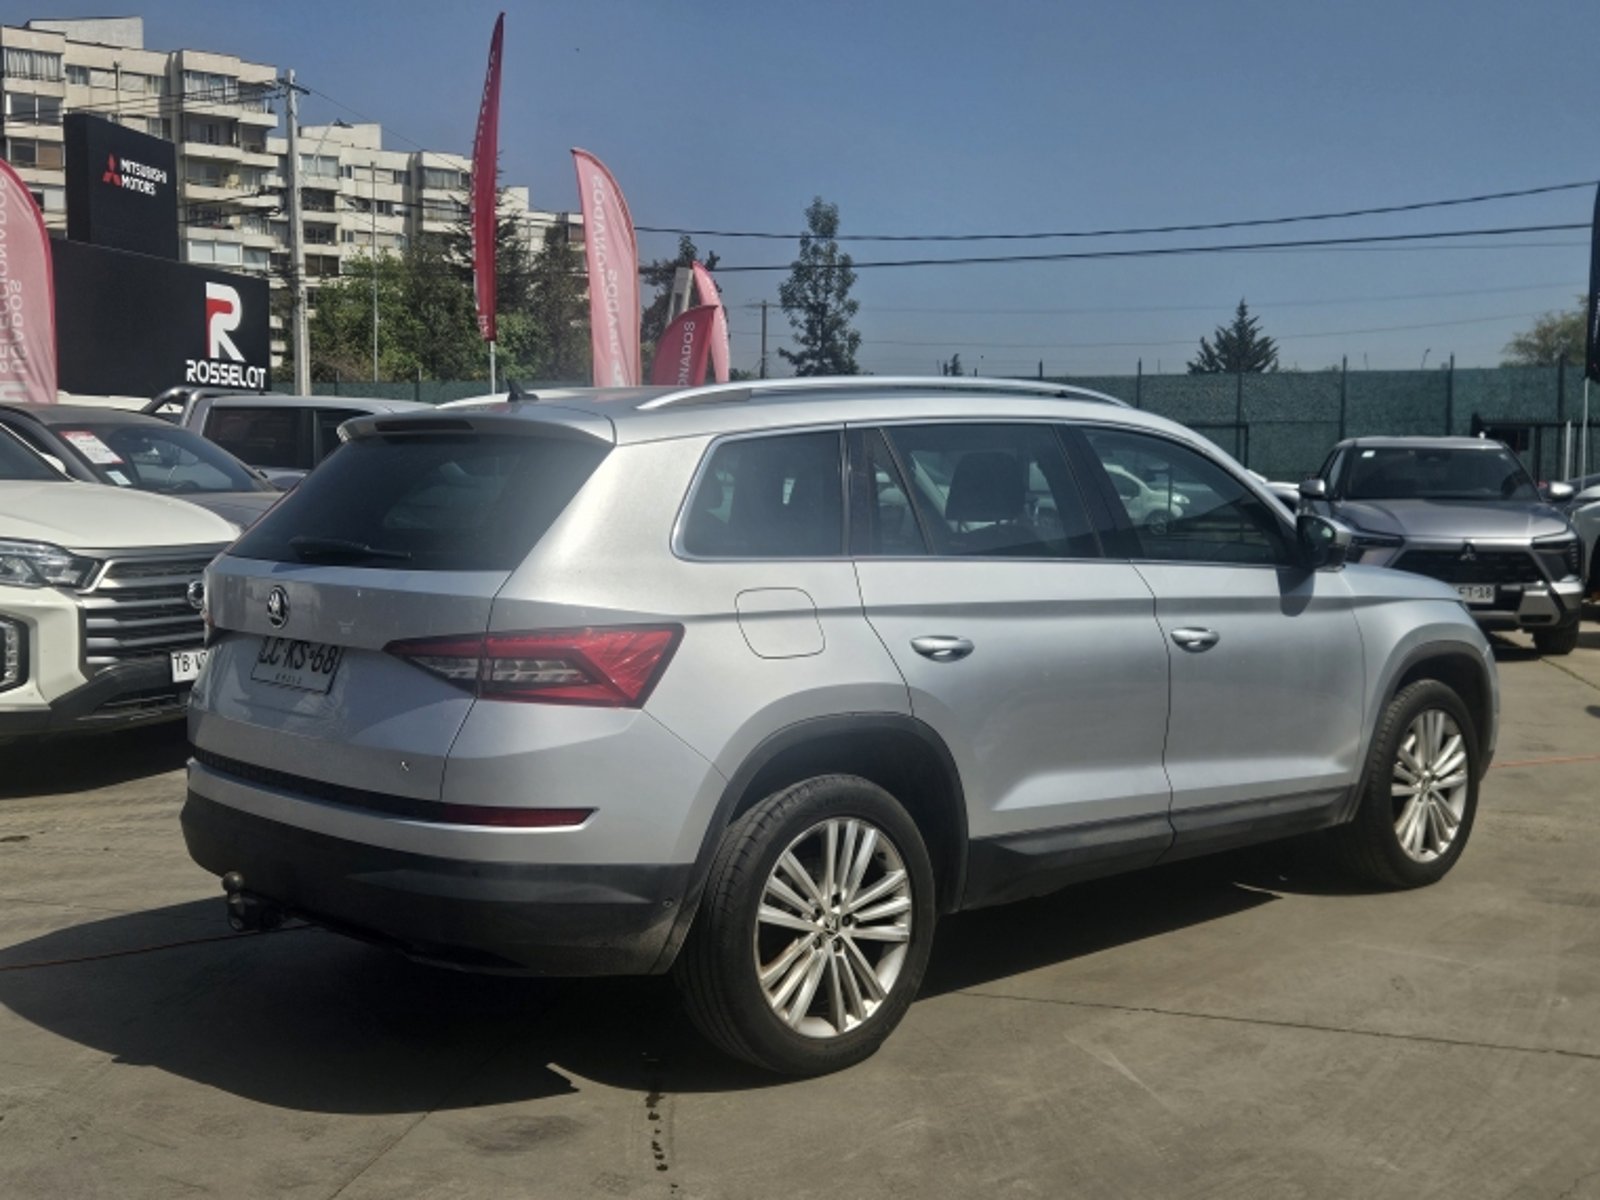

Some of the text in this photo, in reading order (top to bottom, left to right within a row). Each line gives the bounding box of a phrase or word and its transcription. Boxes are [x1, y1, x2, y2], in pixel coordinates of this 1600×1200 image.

[120, 157, 167, 183] MITSUBISHI
[121, 174, 156, 196] MOTORS
[677, 320, 696, 387] ONADOS
[186, 359, 267, 388] ROSSELOT
